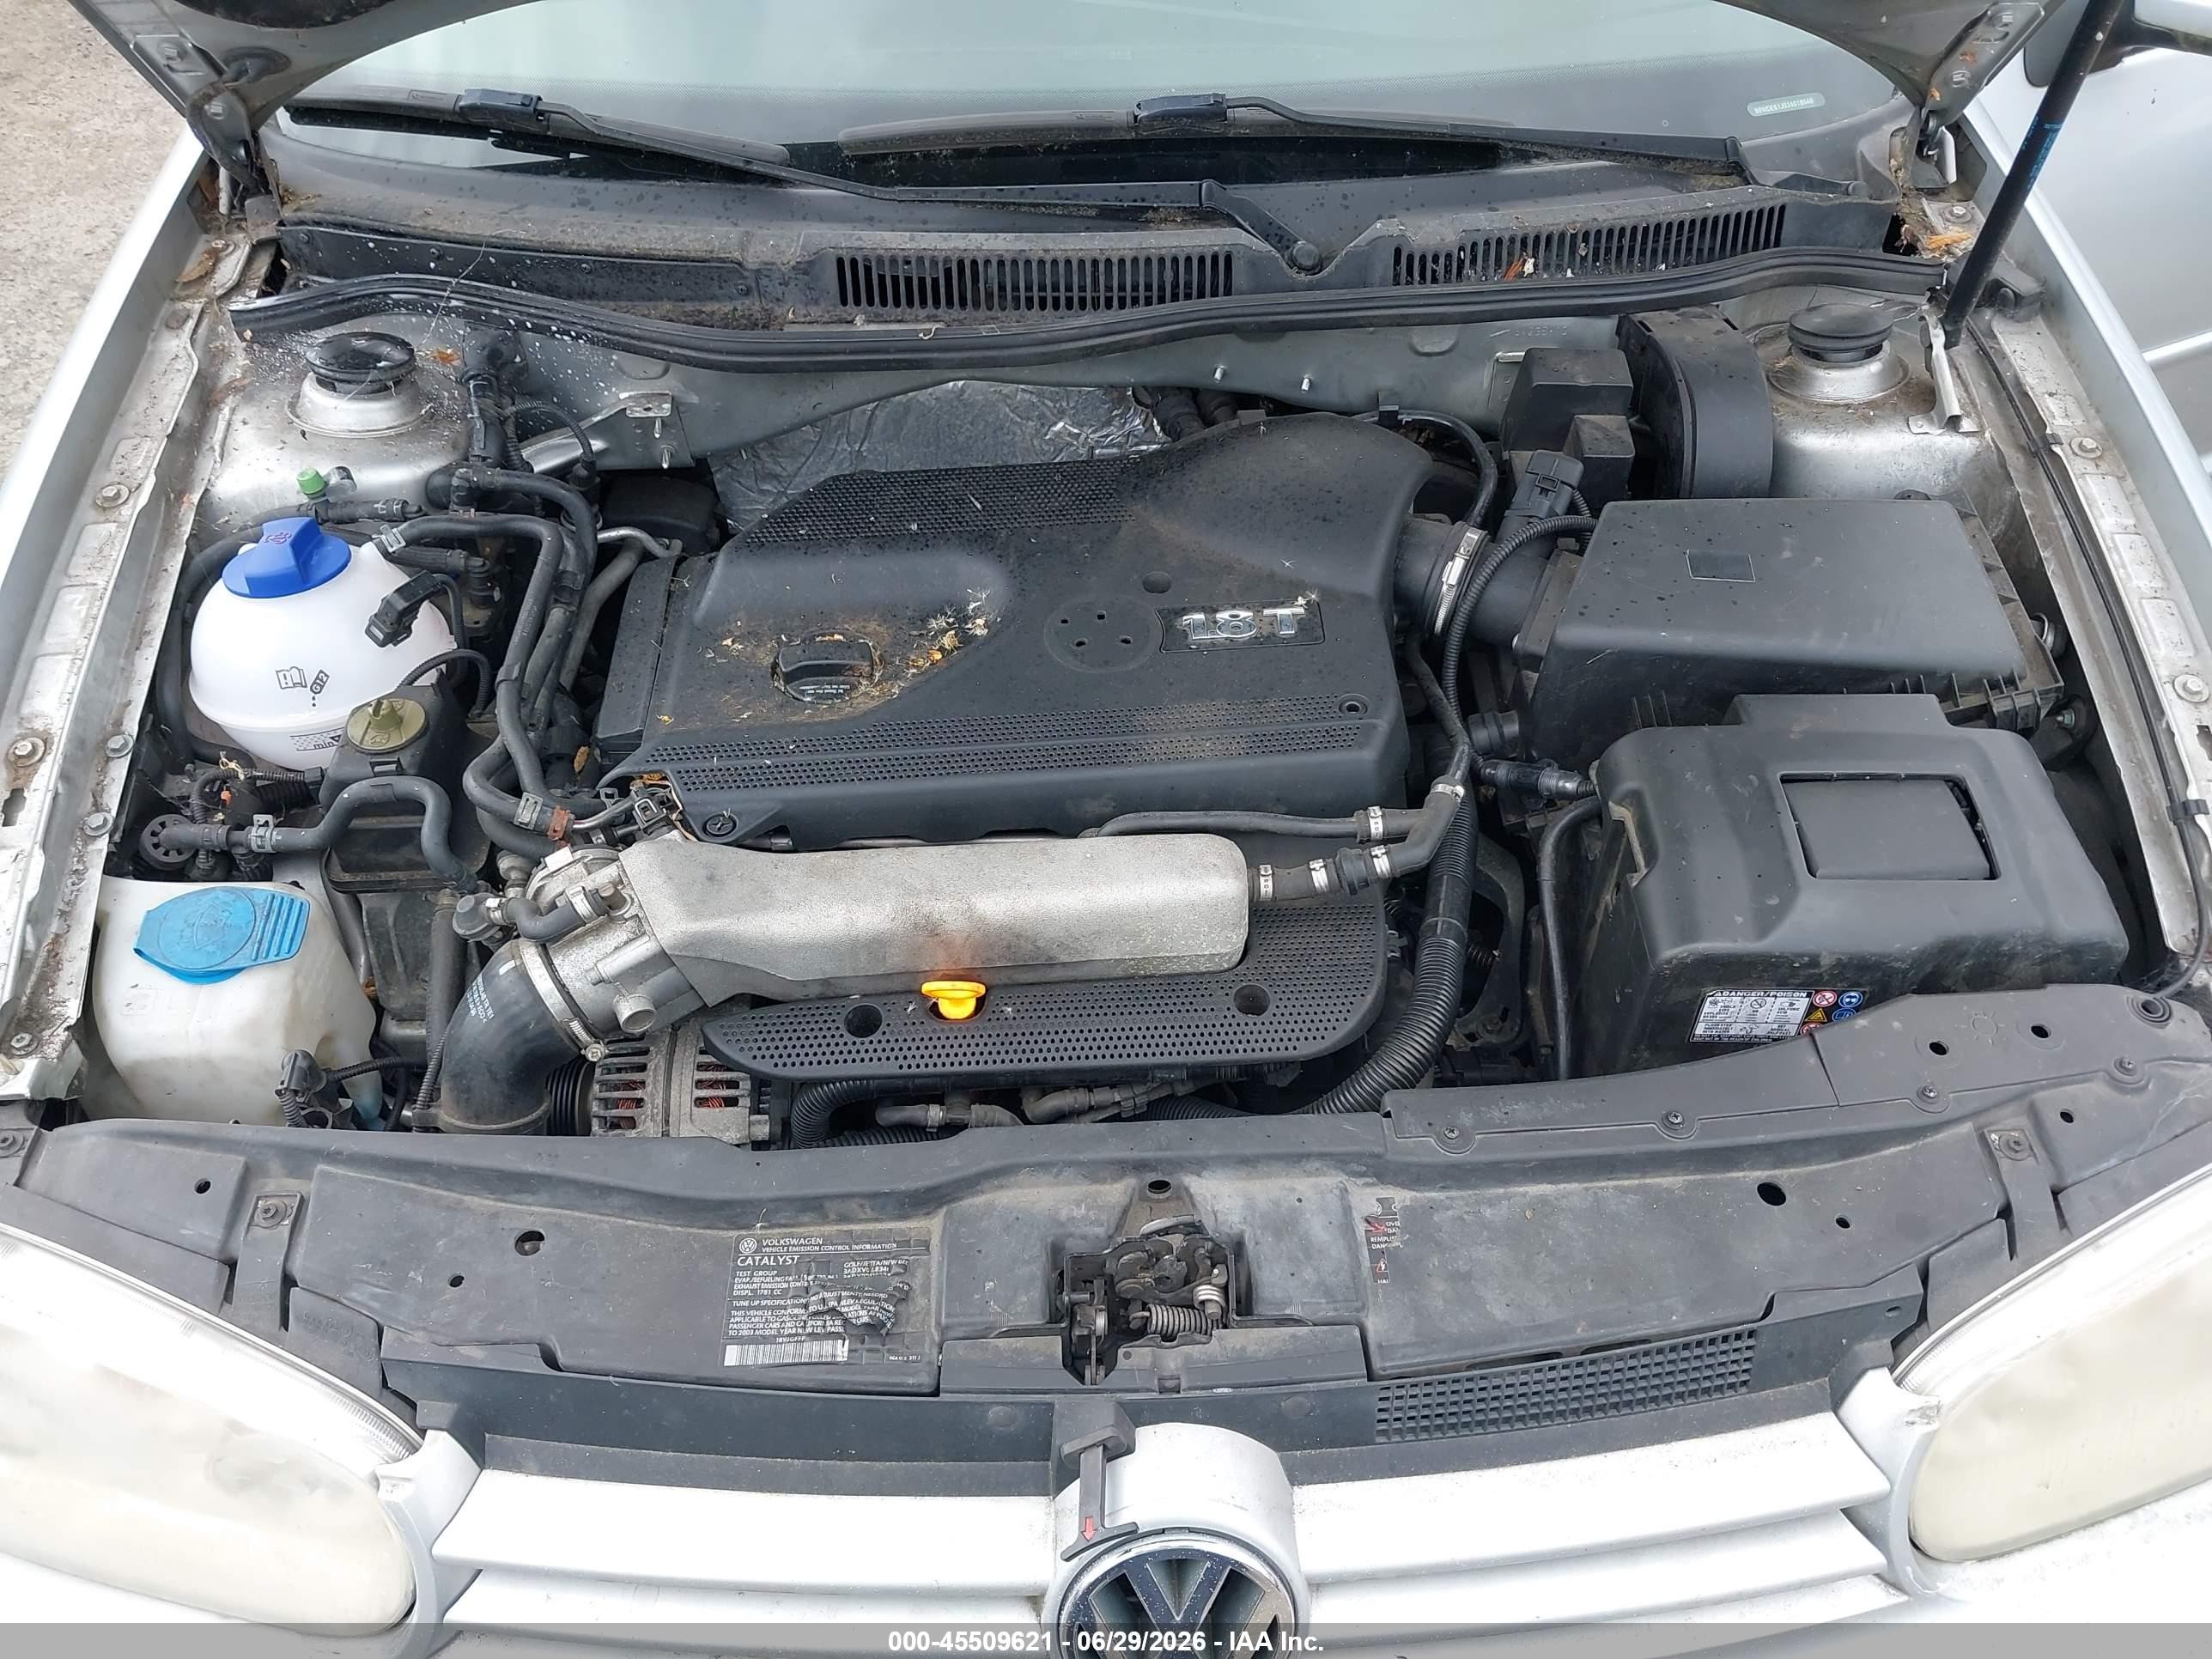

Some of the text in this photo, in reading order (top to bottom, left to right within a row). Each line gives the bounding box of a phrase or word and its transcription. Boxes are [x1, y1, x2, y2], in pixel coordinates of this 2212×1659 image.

[312, 672, 328, 693] G12
[313, 741, 335, 750] min
[762, 1237, 823, 1247] VOLKSWAGEN
[737, 1255, 800, 1266] CATALYST
